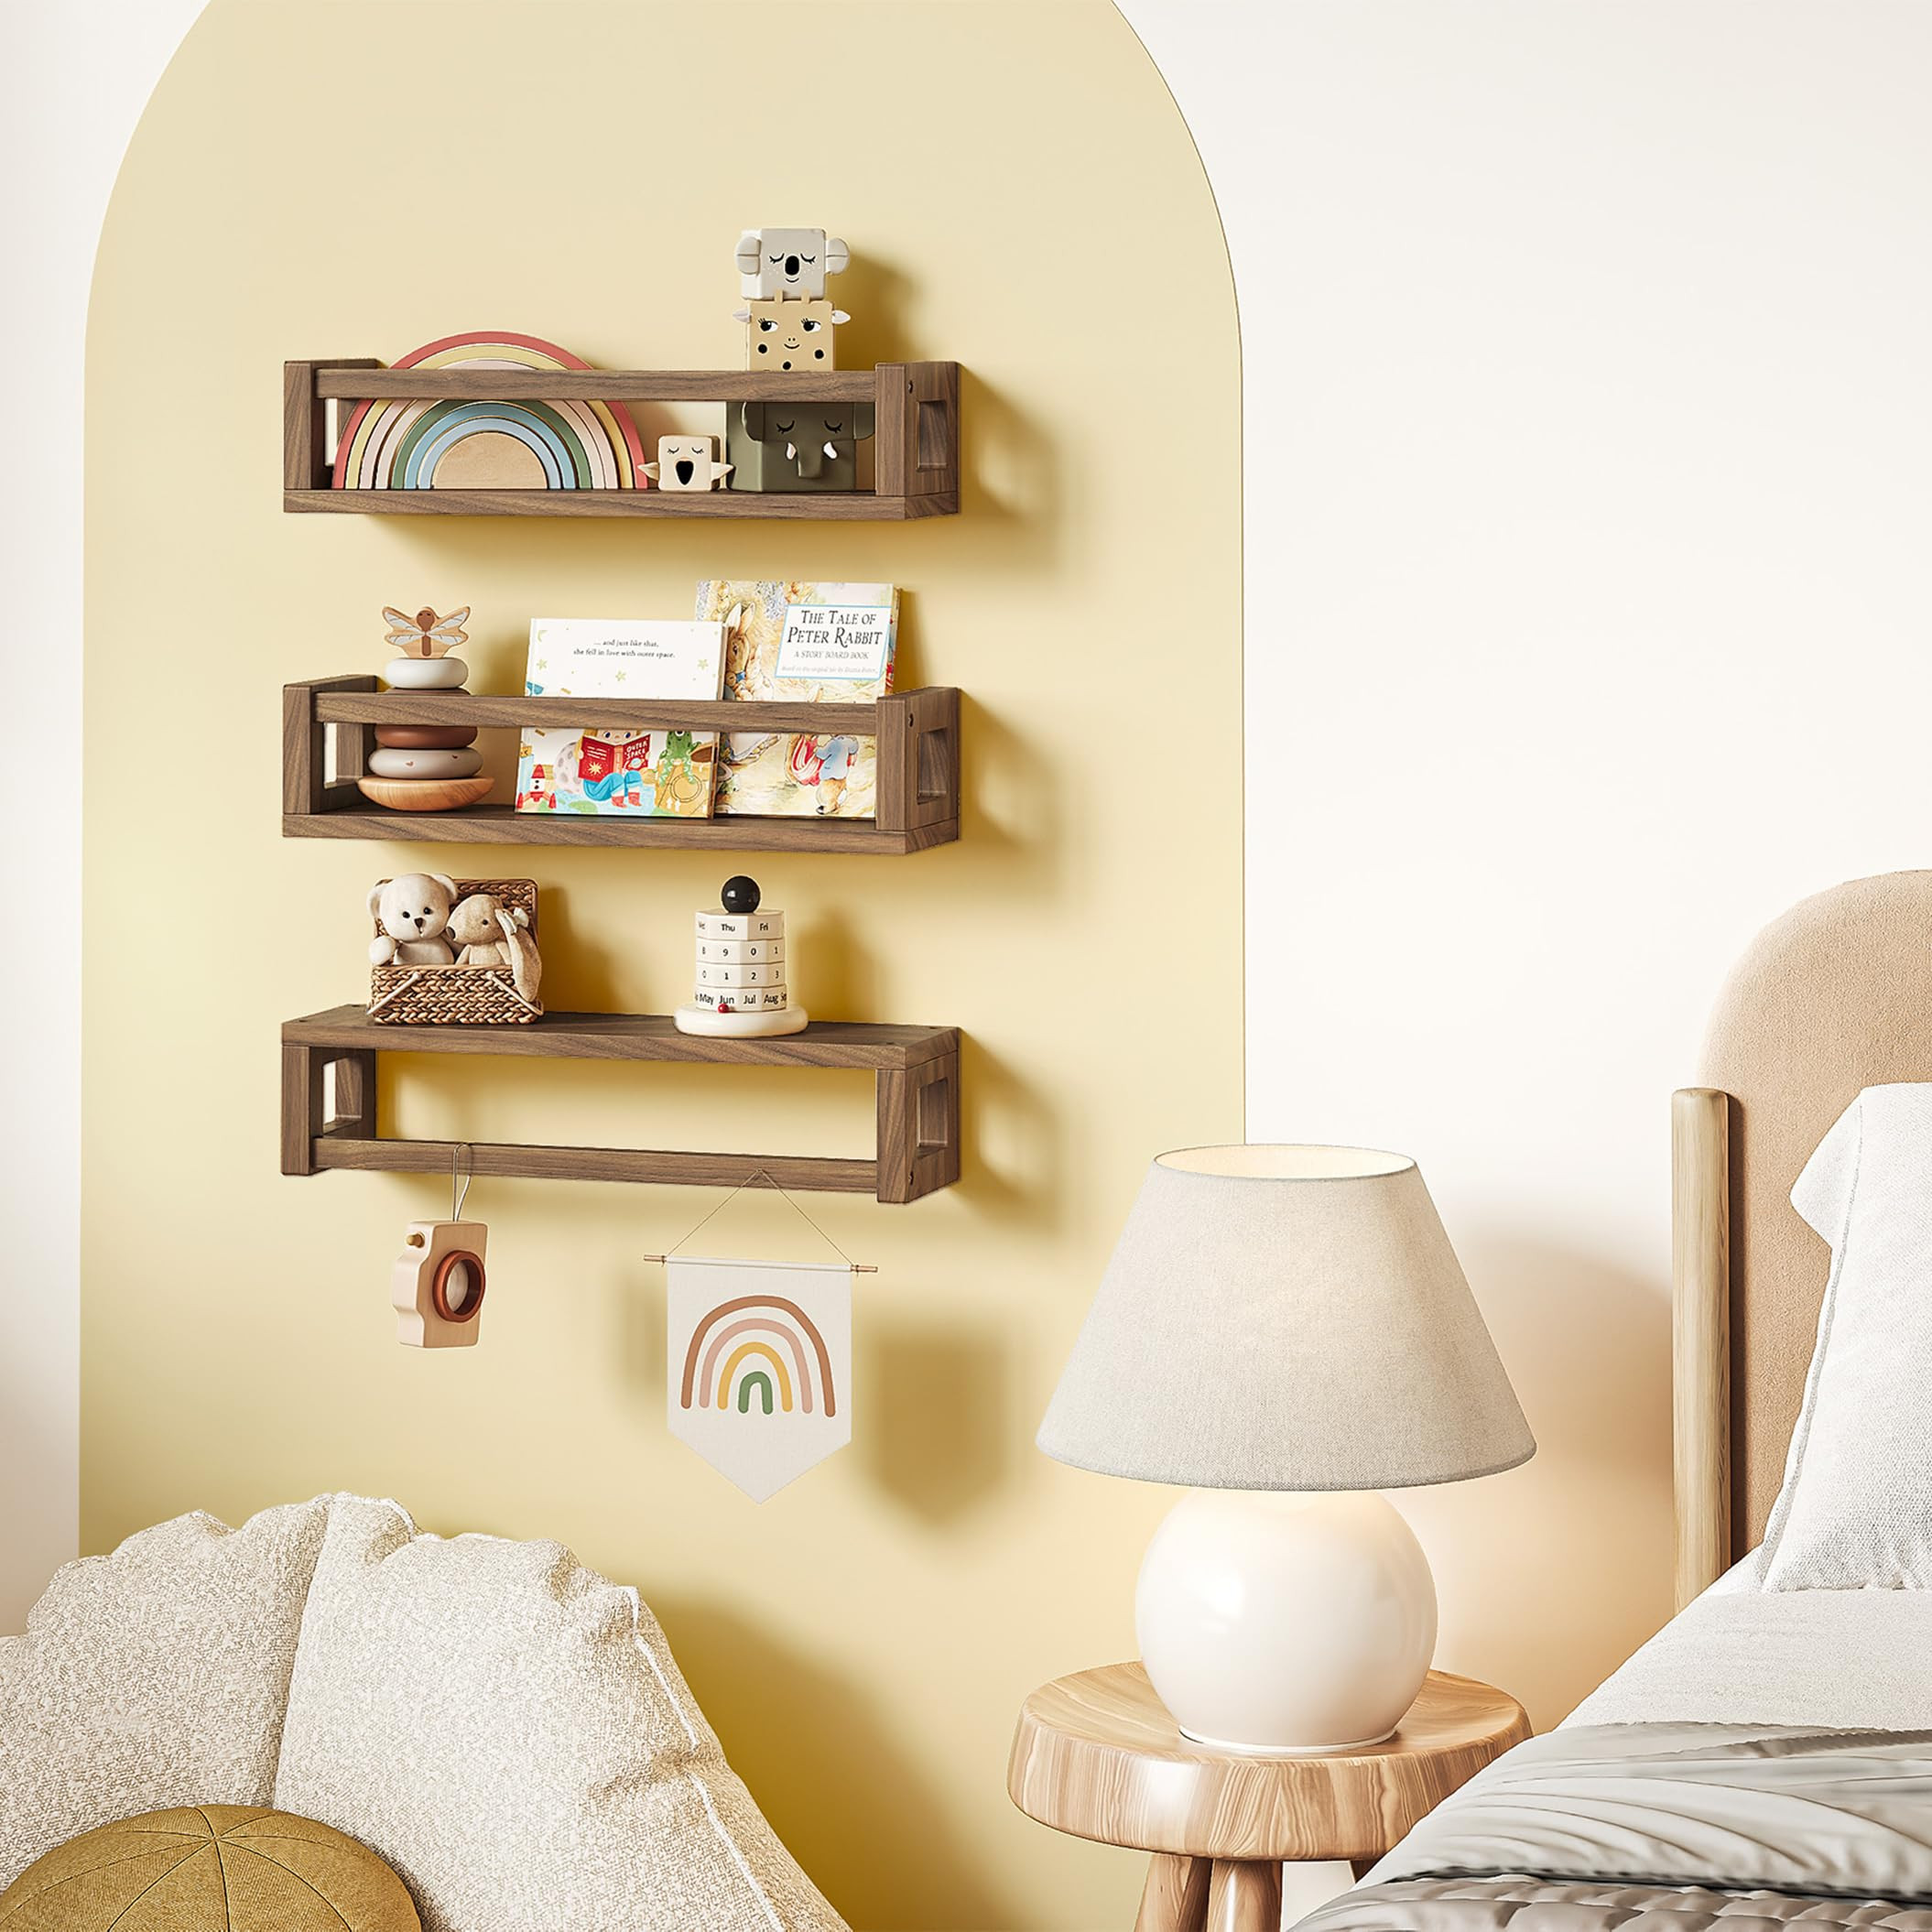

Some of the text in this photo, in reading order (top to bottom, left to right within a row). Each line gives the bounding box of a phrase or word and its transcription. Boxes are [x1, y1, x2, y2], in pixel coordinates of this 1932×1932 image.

[801, 610, 877, 625] THE TALE OF
[787, 626, 884, 648] PETER RABBIT
[721, 922, 769, 932] Thu Fri
[722, 948, 729, 957] 9
[750, 947, 757, 956] 0
[724, 971, 730, 981] 1
[751, 971, 757, 981] 2
[719, 994, 735, 1004] Jun
[743, 993, 756, 1004] Jul
[763, 993, 779, 1004] Aug
